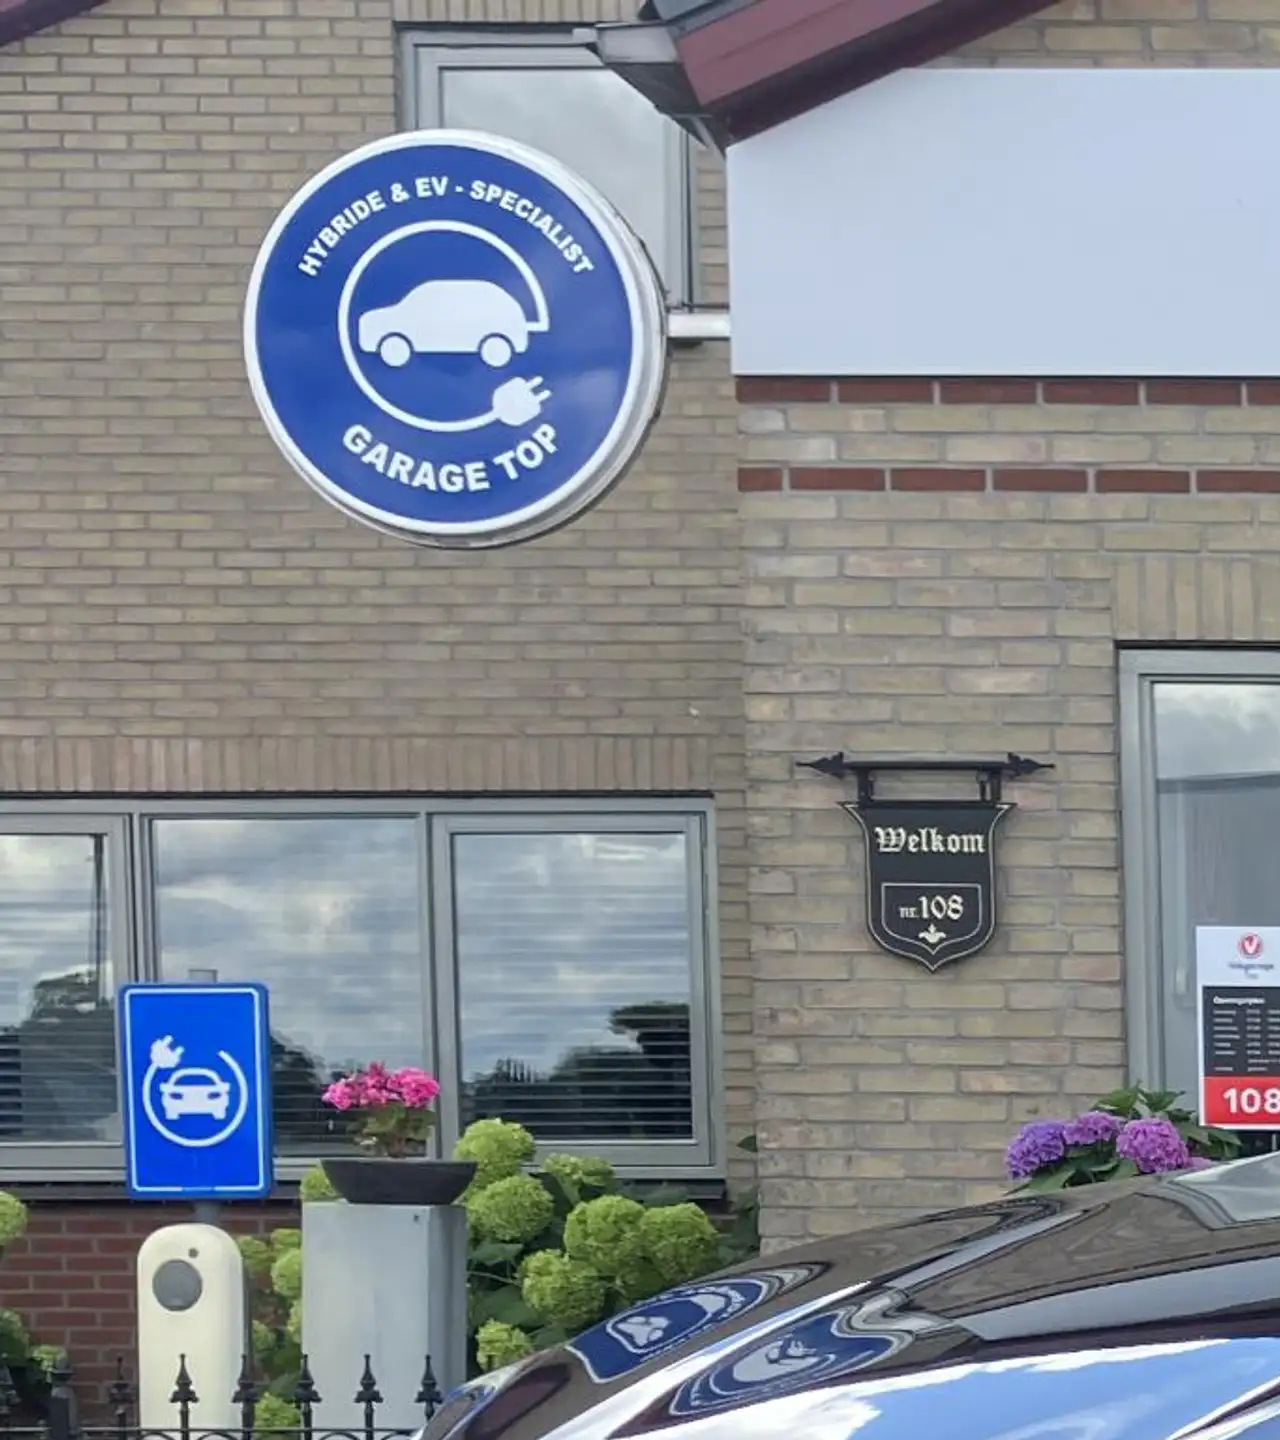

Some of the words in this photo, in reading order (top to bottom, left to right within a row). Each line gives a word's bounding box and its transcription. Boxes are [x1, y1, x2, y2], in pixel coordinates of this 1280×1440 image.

[298, 189, 386, 278] HYBRIDE
[390, 182, 410, 203] &
[415, 176, 449, 198] EV
[469, 179, 595, 274] SPECIALIST
[342, 423, 491, 493] GARAGE
[494, 422, 559, 482] TOP
[873, 826, 986, 854] Welkom
